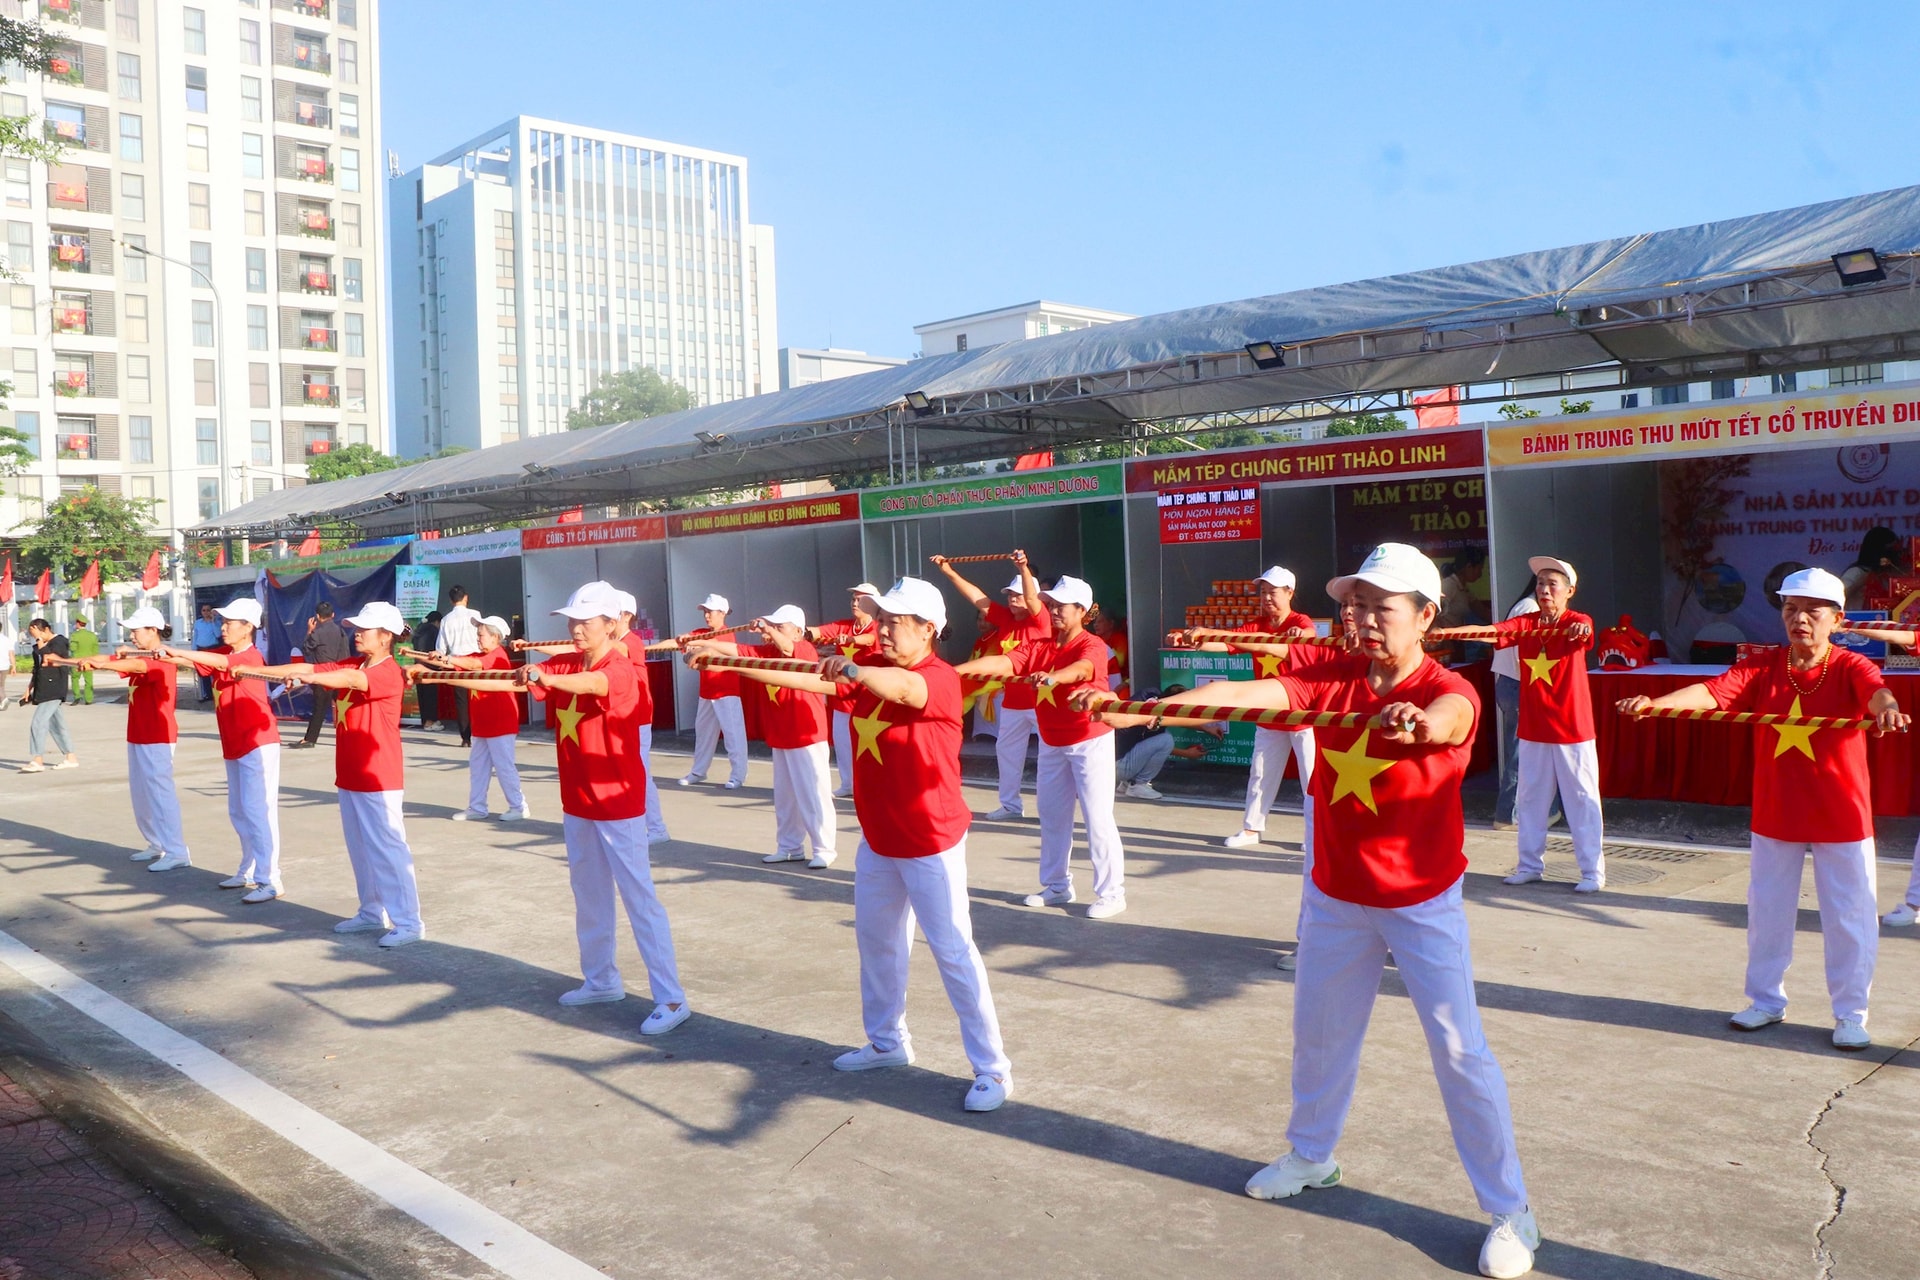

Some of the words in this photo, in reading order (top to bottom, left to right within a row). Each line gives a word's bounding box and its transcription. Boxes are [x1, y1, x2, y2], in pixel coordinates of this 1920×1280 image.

[1522, 432, 1569, 455] BÁNH
[1574, 429, 1634, 450] TRUNG
[1639, 424, 1674, 444] THU
[1680, 417, 1721, 440] MỨT
[1728, 412, 1761, 437] TẾT
[1768, 406, 1796, 434] CỔ
[1802, 400, 1885, 431] TRUYỀN
[1153, 462, 1191, 485] MẮM
[1195, 462, 1225, 480] TÉP
[1230, 458, 1291, 478] CHƯNG
[1296, 454, 1336, 475] THỊT
[1341, 446, 1394, 469] THẢO
[1399, 445, 1446, 465] LINH
[879, 497, 905, 513] CÔNG
[907, 496, 919, 509] TY
[921, 489, 936, 507] CỔ
[966, 487, 993, 505] THỰC
[1028, 481, 1056, 497] MINH
[1058, 476, 1099, 494] DƯƠNG
[1208, 489, 1221, 505] THỊT
[1240, 488, 1256, 501] LINH
[1353, 482, 1400, 506] MẮM
[1406, 479, 1447, 502] TÉP
[1744, 491, 1788, 512] NHÀ
[1793, 488, 1835, 511] SẢN
[1840, 486, 1899, 508] XUẤT
[681, 517, 693, 534] HỘ
[694, 516, 713, 530] KINH
[714, 514, 742, 528] DOANH
[743, 510, 766, 525] BÁNH
[767, 508, 785, 525] KẸO
[786, 504, 808, 520] BÌNH
[809, 502, 842, 517] CHUNG
[1186, 507, 1212, 519] NGON
[1211, 520, 1227, 529] OCOP
[1410, 505, 1471, 532] THẢO
[1747, 519, 1806, 535] TRUNG
[1809, 517, 1848, 533] THU
[545, 531, 564, 545] CÔNG
[566, 531, 575, 543] TY
[610, 526, 637, 540] LAVITE
[1178, 532, 1189, 541] ĐT
[1194, 531, 1211, 540] 0375
[1212, 530, 1226, 540] 459
[1227, 530, 1240, 539] 623
